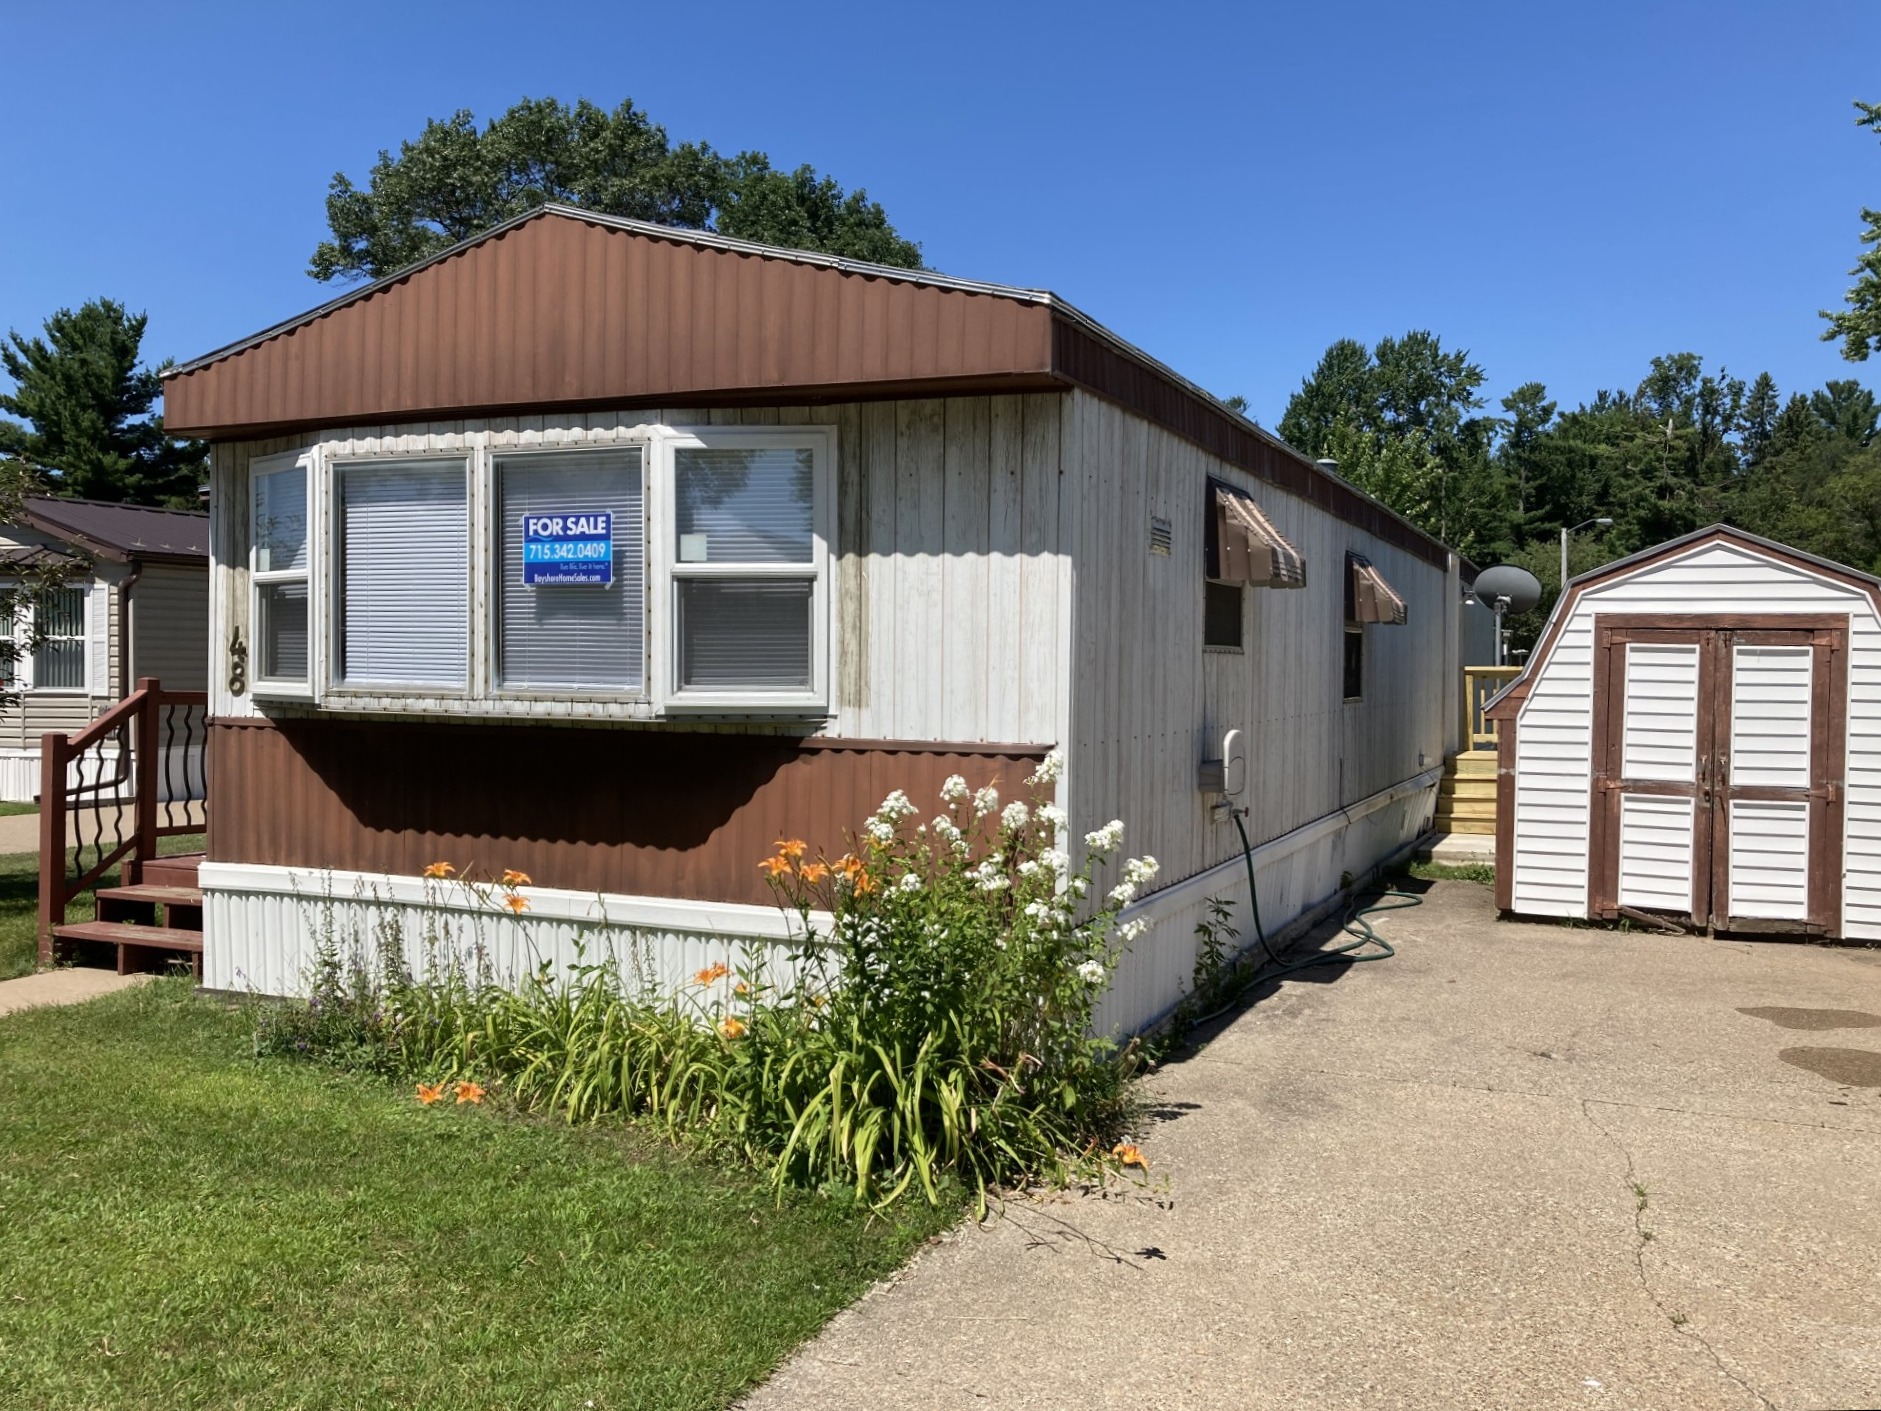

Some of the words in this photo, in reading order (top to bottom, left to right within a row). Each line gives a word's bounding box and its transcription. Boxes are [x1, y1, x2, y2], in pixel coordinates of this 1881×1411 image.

[528, 518, 564, 536] FOR
[566, 516, 606, 535] SALE
[529, 543, 606, 559] 715.342.0409
[534, 573, 600, 584] BayshoreHomeSales.com
